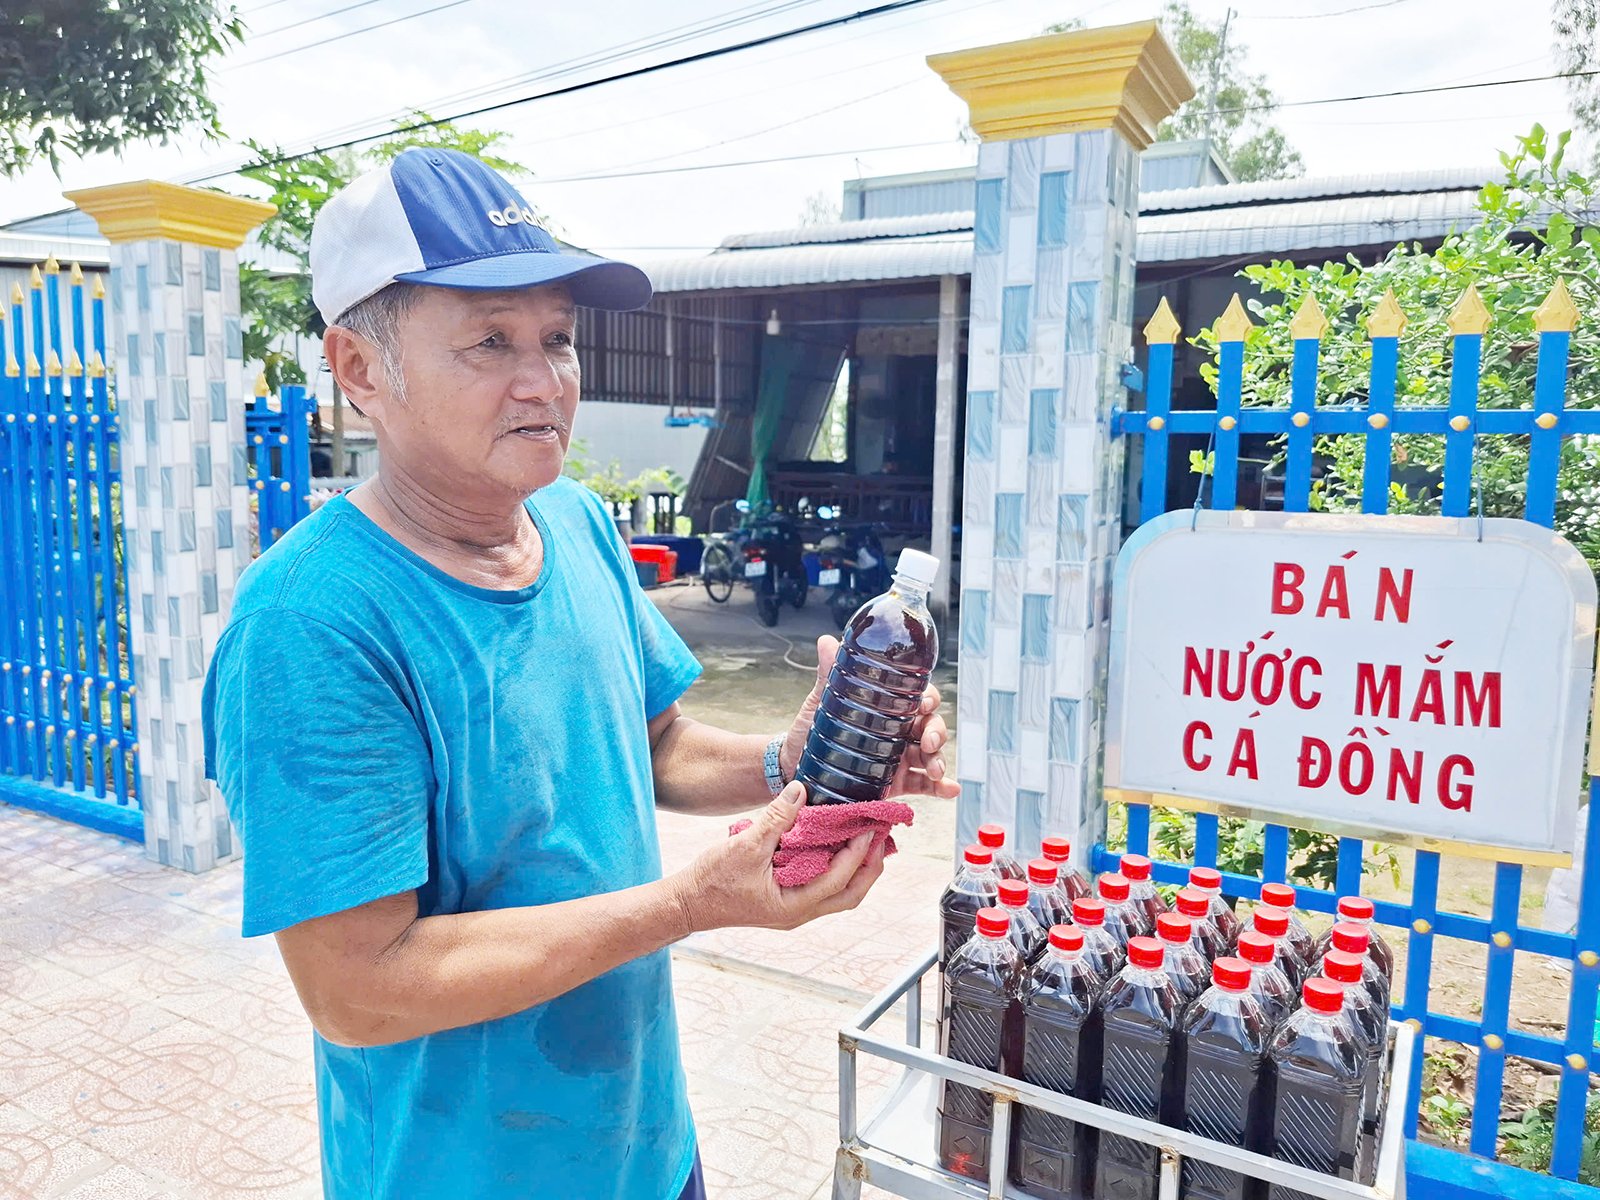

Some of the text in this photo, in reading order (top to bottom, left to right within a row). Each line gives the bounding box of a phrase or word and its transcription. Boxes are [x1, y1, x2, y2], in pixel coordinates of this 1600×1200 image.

[1271, 550, 1414, 624] BÁN
[1182, 630, 1502, 728] NƯỚC MẮM
[1182, 711, 1475, 813] CÁ ĐỒNG
